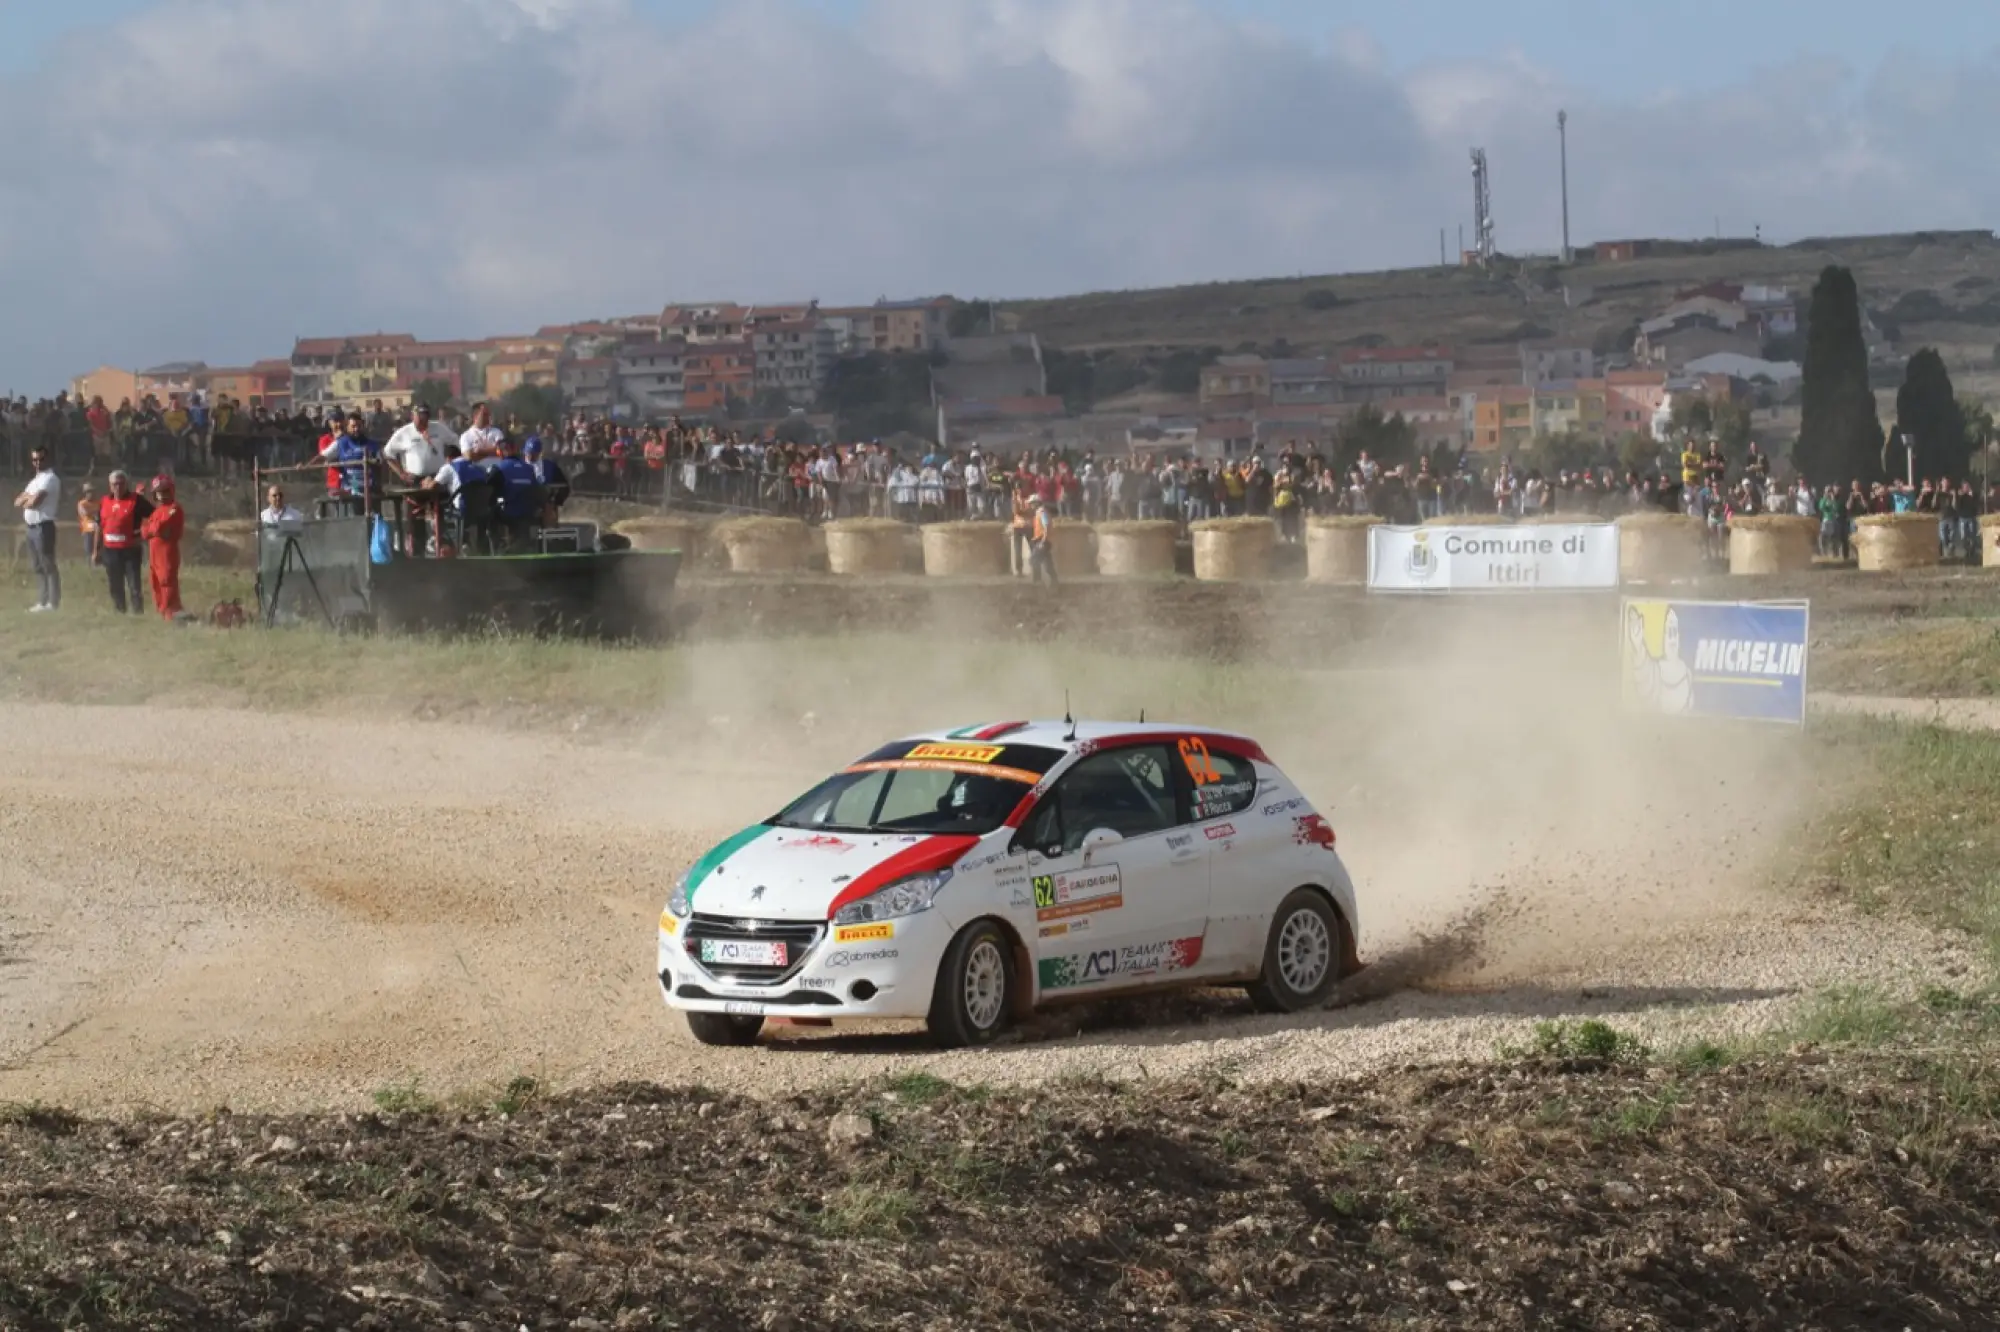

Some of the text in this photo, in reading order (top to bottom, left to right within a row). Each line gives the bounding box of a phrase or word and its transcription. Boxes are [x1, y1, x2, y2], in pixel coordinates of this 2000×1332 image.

[1444, 534, 1586, 556] Comune di
[1487, 562, 1541, 584] Ittiri
[1694, 638, 1803, 677] MICHELIN
[911, 745, 998, 759] PIRELLI
[1178, 736, 1221, 785] 62
[1034, 875, 1054, 907] 62
[839, 925, 888, 940] PIRELLI
[1082, 949, 1117, 978] ACI
